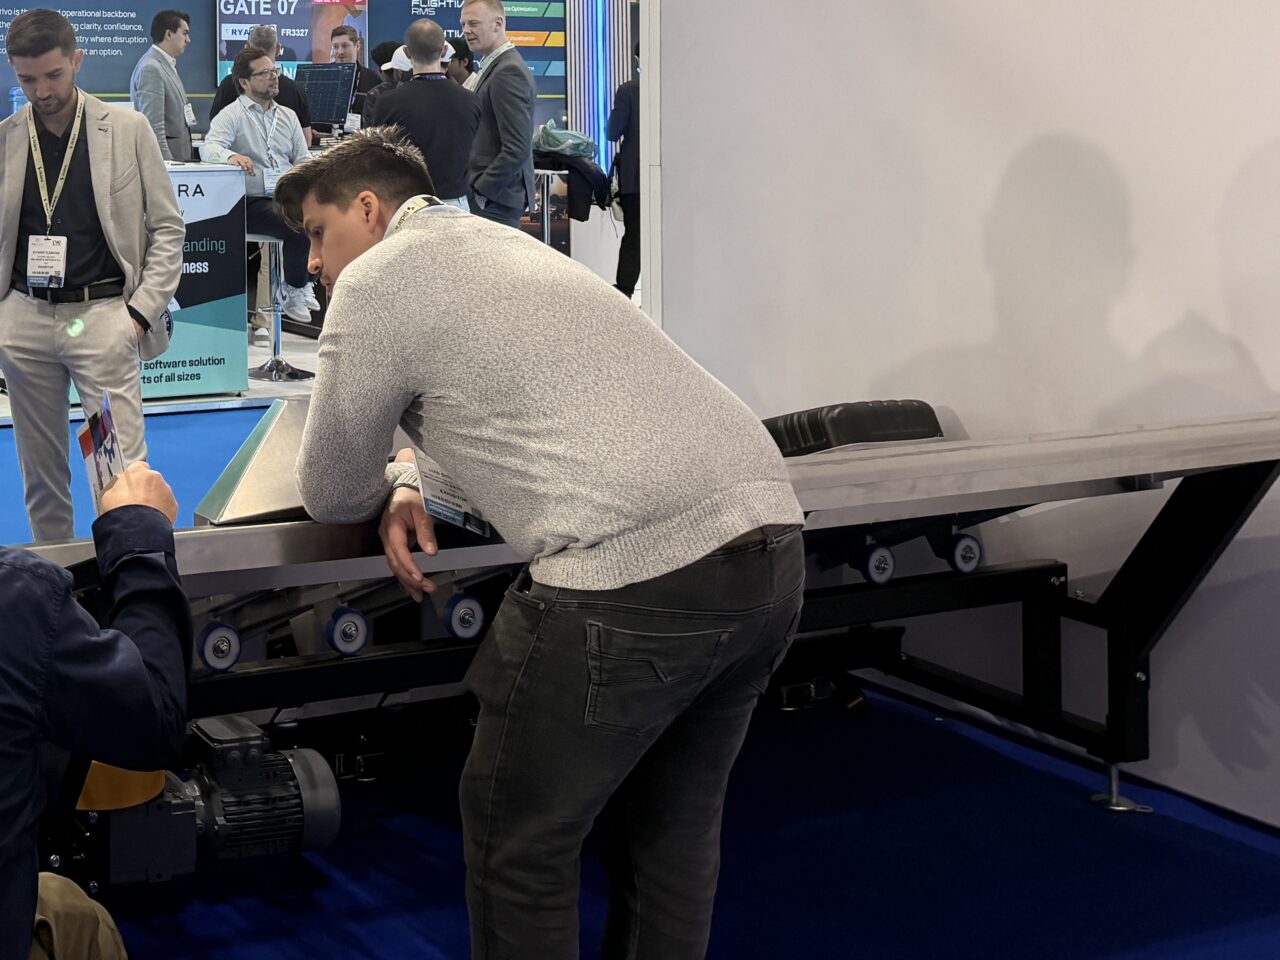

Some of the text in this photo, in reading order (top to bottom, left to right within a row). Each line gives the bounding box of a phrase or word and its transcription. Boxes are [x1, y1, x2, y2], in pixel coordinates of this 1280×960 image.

[13, 7, 20, 16] is
[61, 8, 102, 20] operational
[102, 9, 137, 18] backbone
[411, 7, 436, 16] RMS
[80, 22, 103, 32] clarity,
[103, 22, 144, 32] confidence,
[281, 28, 309, 37] FR3327
[90, 35, 111, 44] where
[112, 35, 148, 45] disruption
[98, 48, 124, 58] option.
[144, 355, 226, 371] software solution
[153, 372, 164, 384] of
[164, 372, 176, 383] all
[176, 371, 201, 382] sizes
